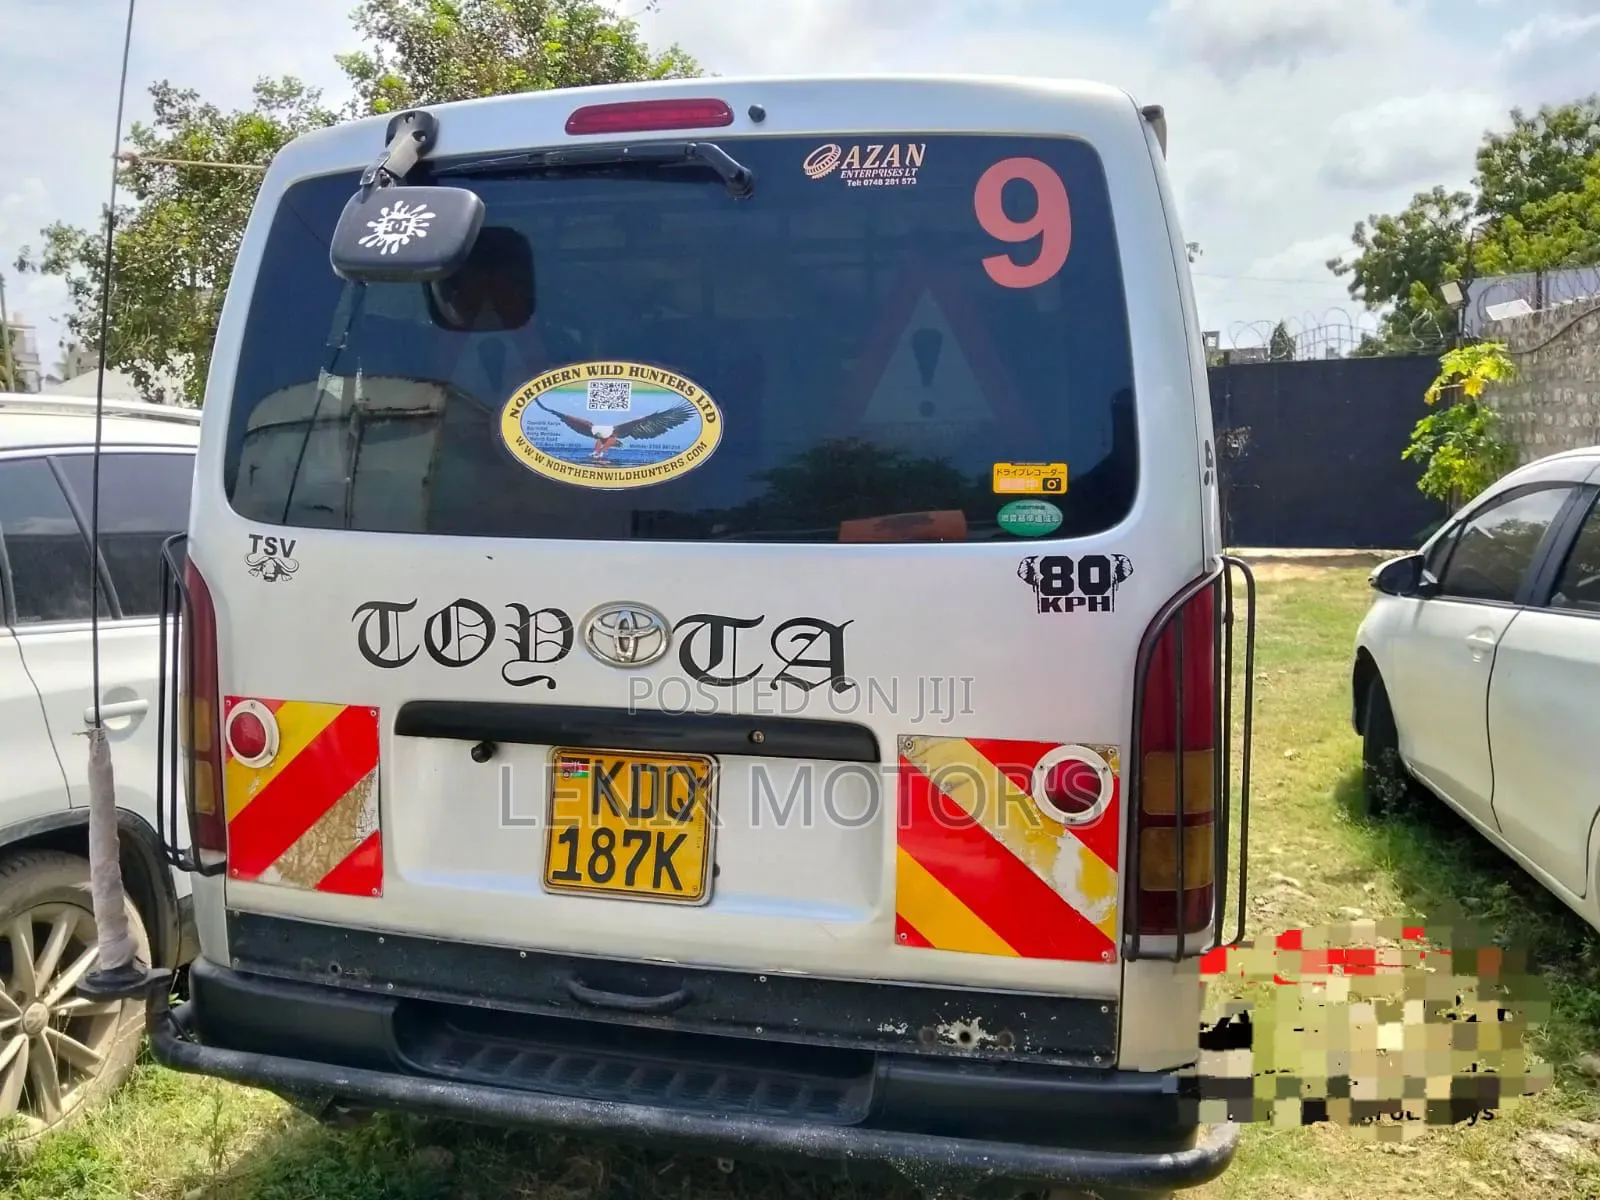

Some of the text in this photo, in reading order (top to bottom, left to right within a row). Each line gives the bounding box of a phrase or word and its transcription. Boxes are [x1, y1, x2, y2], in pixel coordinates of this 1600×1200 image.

[840, 143, 927, 169] AZAN
[840, 167, 919, 179] ENTERPRISES LT
[846, 179, 862, 187] Tel:
[901, 177, 917, 185] 573
[974, 157, 1072, 289] 9
[509, 364, 717, 425] NORTHERN WILD HUNTERS LTD
[248, 533, 297, 558] TSV
[1039, 554, 1112, 597] 80
[1040, 596, 1111, 613] KPH
[592, 758, 696, 822] KDQ
[552, 826, 689, 892] 187K
